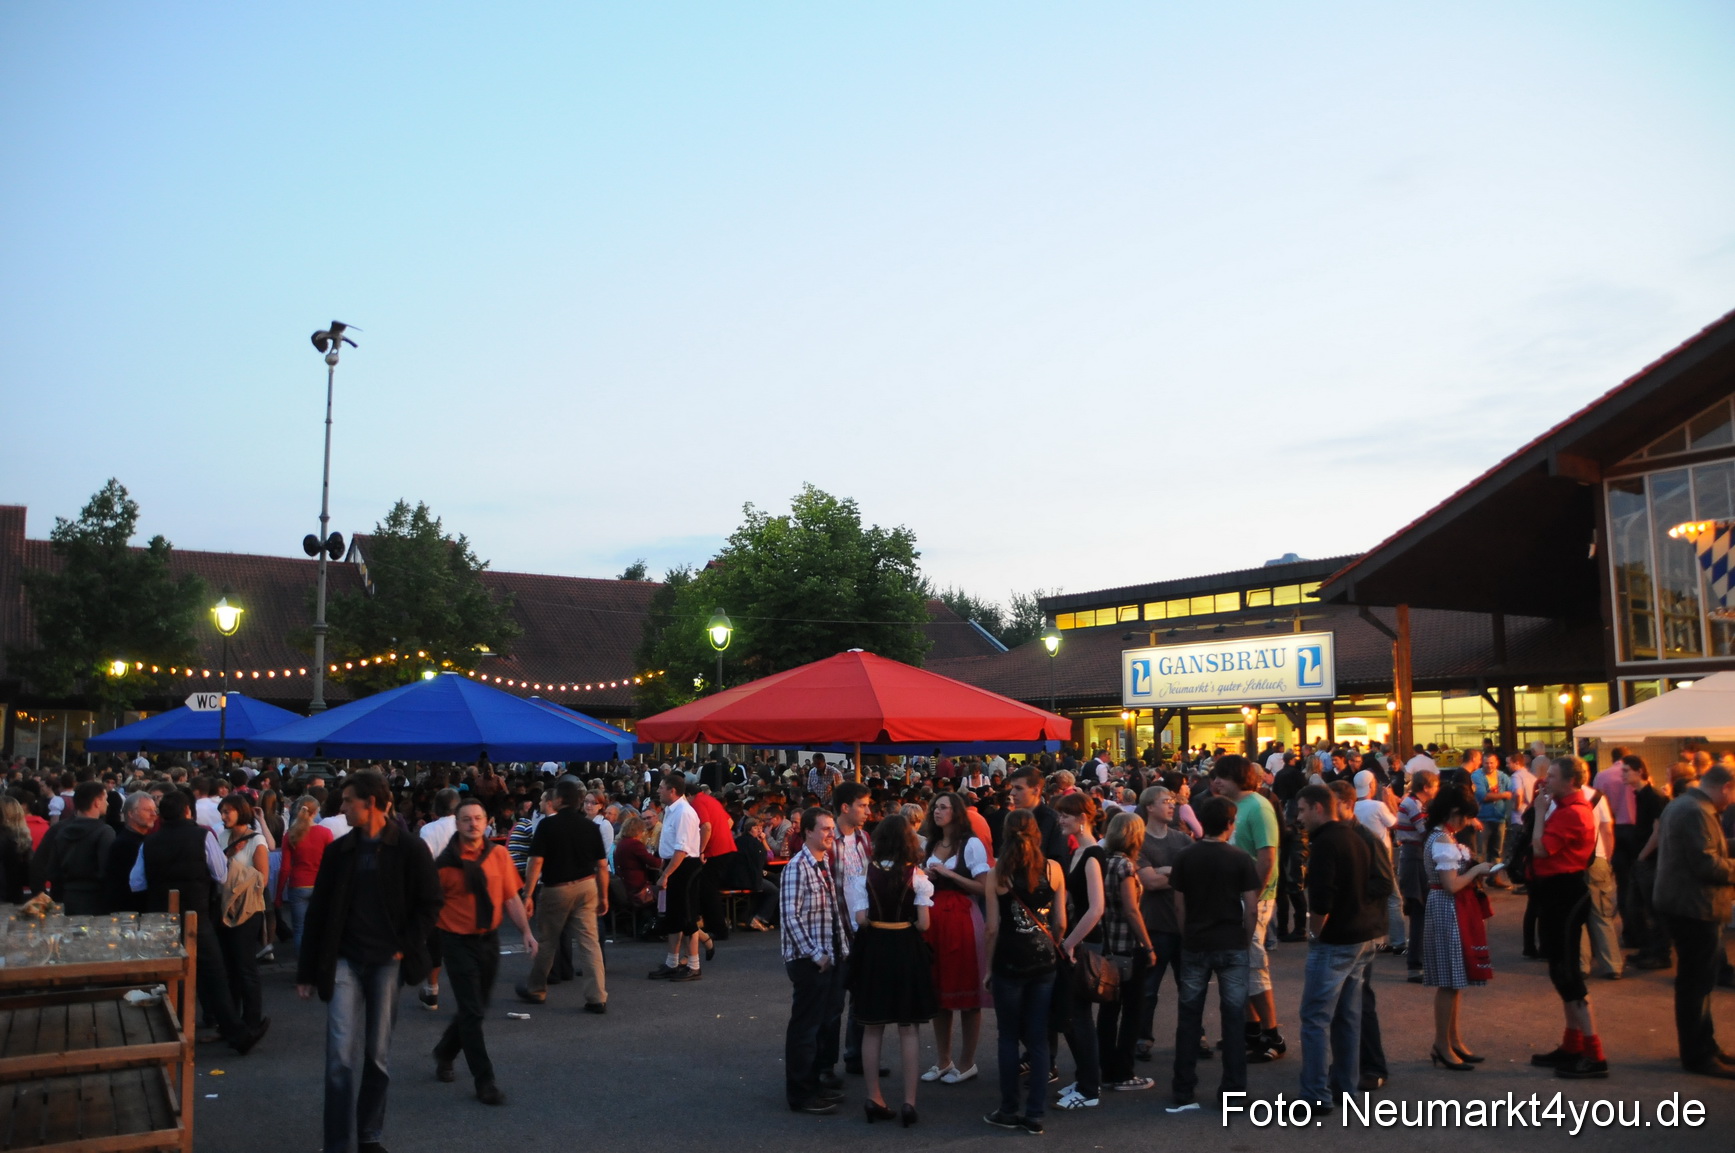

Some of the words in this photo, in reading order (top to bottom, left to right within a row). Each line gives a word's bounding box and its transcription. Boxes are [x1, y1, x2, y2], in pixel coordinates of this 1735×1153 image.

[1158, 647, 1287, 677] GANSBRÄU
[1159, 681, 1215, 698] Neumarkt's
[1217, 681, 1242, 696] guter
[1242, 678, 1287, 693] Schluck
[196, 694, 218, 709] WC
